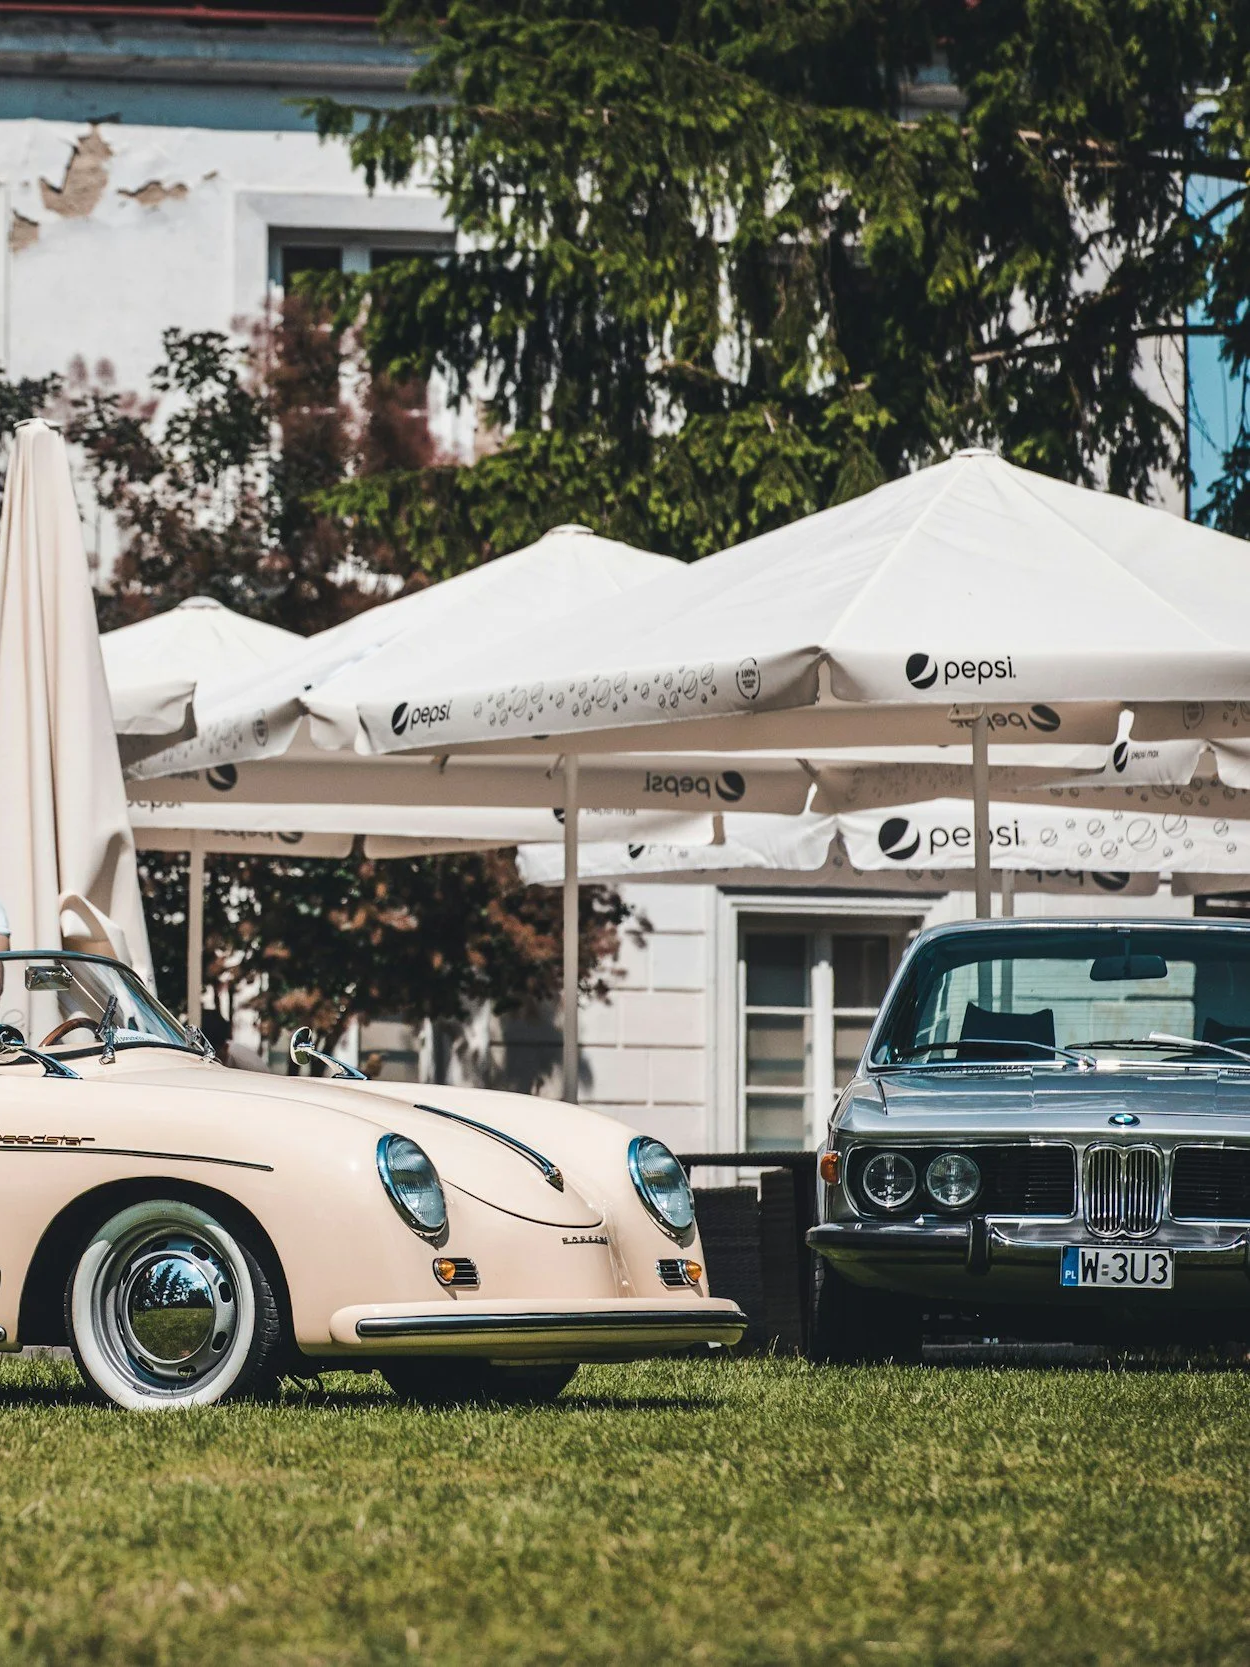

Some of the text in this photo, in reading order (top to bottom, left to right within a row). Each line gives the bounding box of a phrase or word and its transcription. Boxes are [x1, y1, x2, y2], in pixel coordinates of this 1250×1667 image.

[944, 656, 1013, 685] pepsi
[410, 699, 453, 731] pepsi
[929, 820, 1020, 855] pesi
[1065, 1270, 1077, 1280] PL
